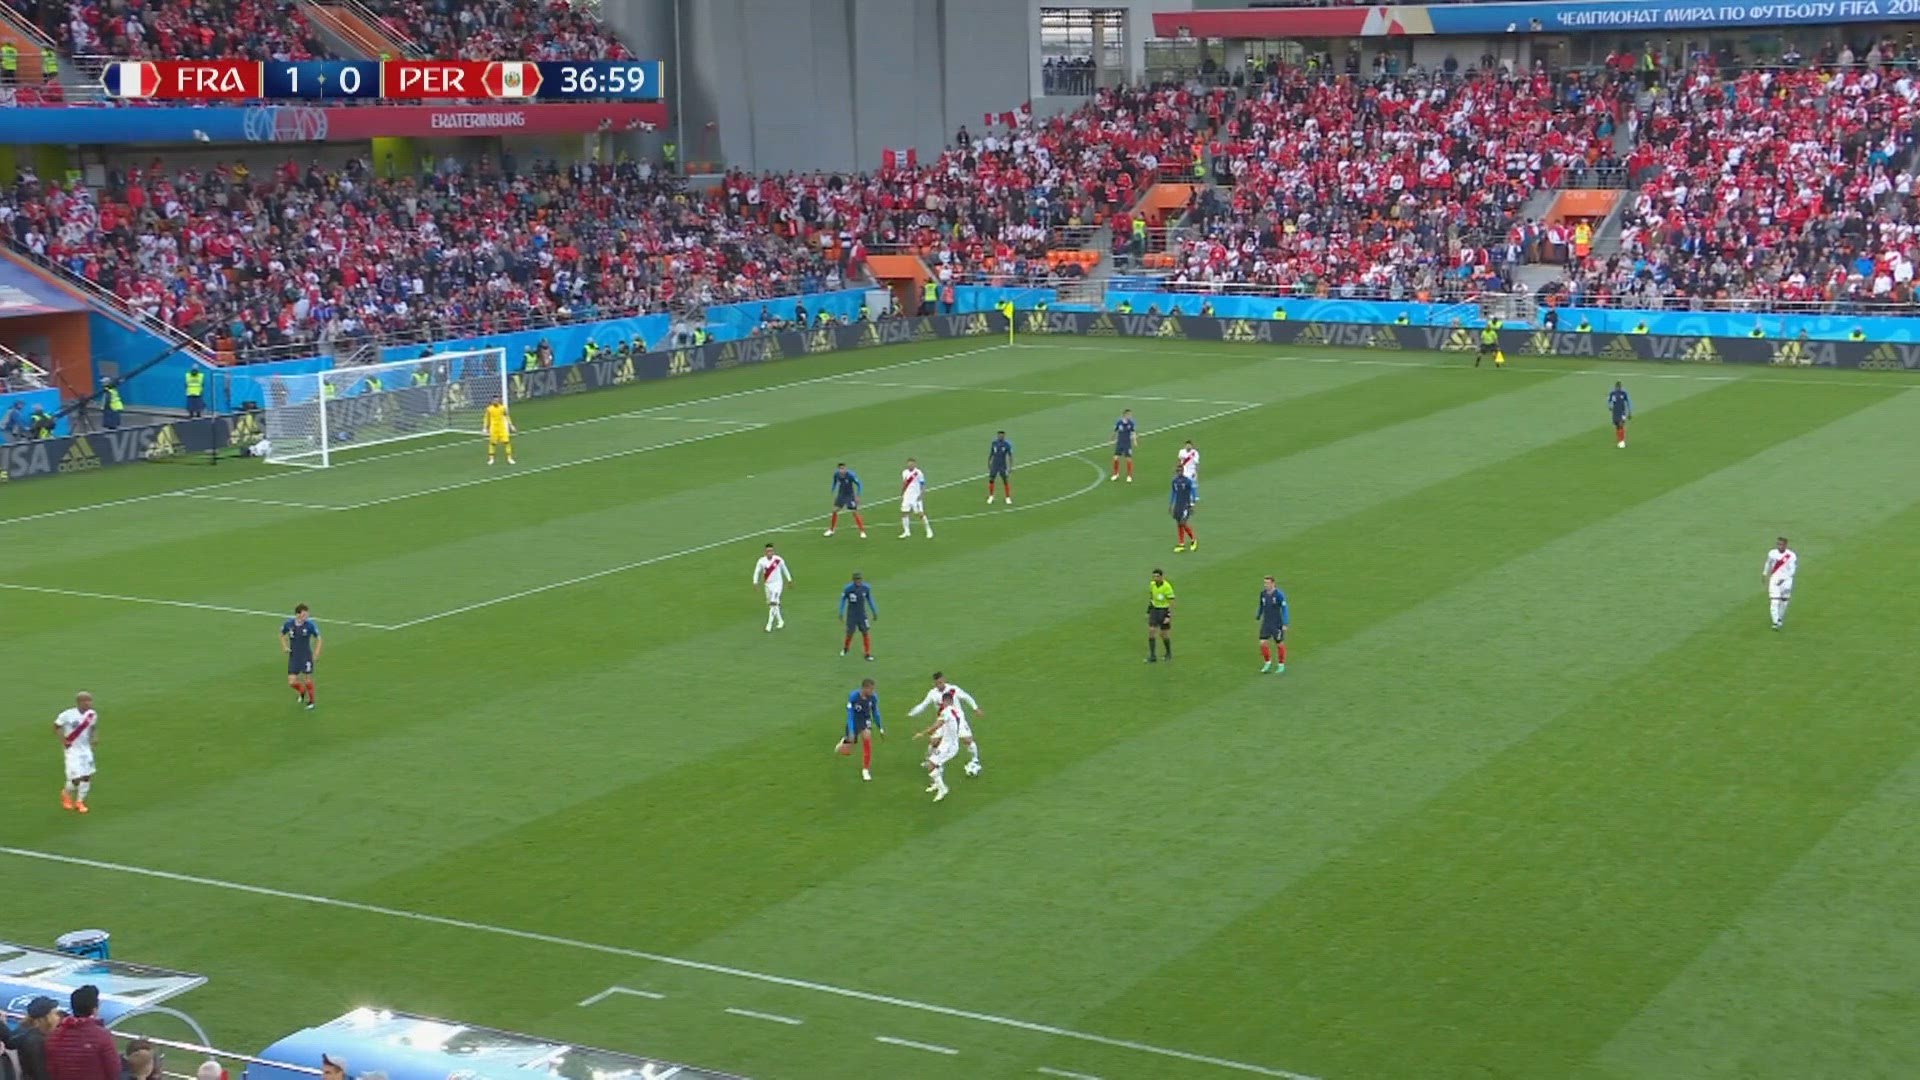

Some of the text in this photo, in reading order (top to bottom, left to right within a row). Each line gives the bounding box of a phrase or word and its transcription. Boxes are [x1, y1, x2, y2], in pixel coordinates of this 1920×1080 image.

[1557, 0, 1920, 25] ЧЕМПИОНАТ МИРА ПО ФУТБОЛУ FIFA 201
[431, 112, 526, 129] EKATERINBURG
[878, 320, 913, 343] VISA
[1320, 323, 1374, 346] VISA
